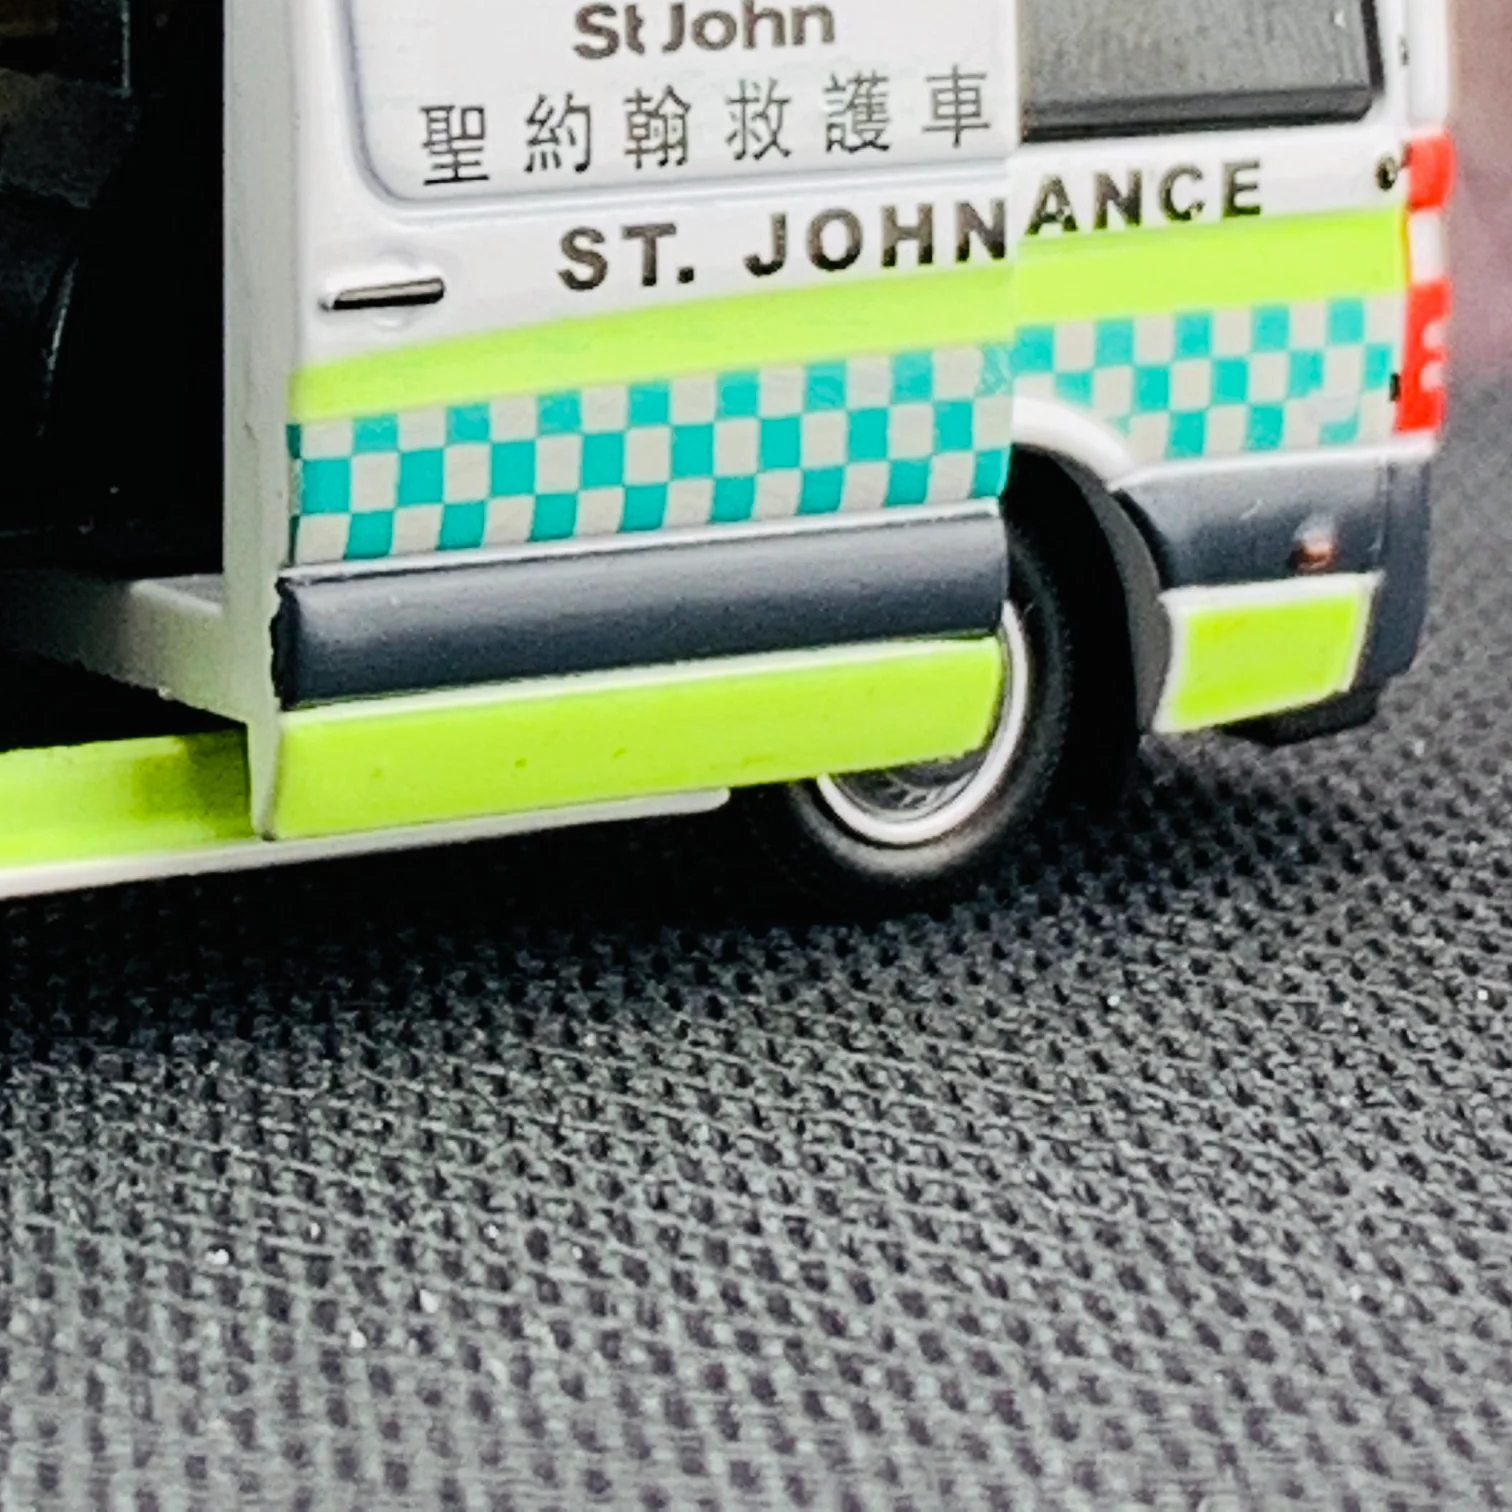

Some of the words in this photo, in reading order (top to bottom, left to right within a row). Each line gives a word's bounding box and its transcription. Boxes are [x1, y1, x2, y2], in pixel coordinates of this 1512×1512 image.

[572, 1, 646, 59] St
[419, 63, 992, 186] 聖約翰救護車
[557, 222, 695, 291] ST.
[743, 198, 1008, 278] JOHN
